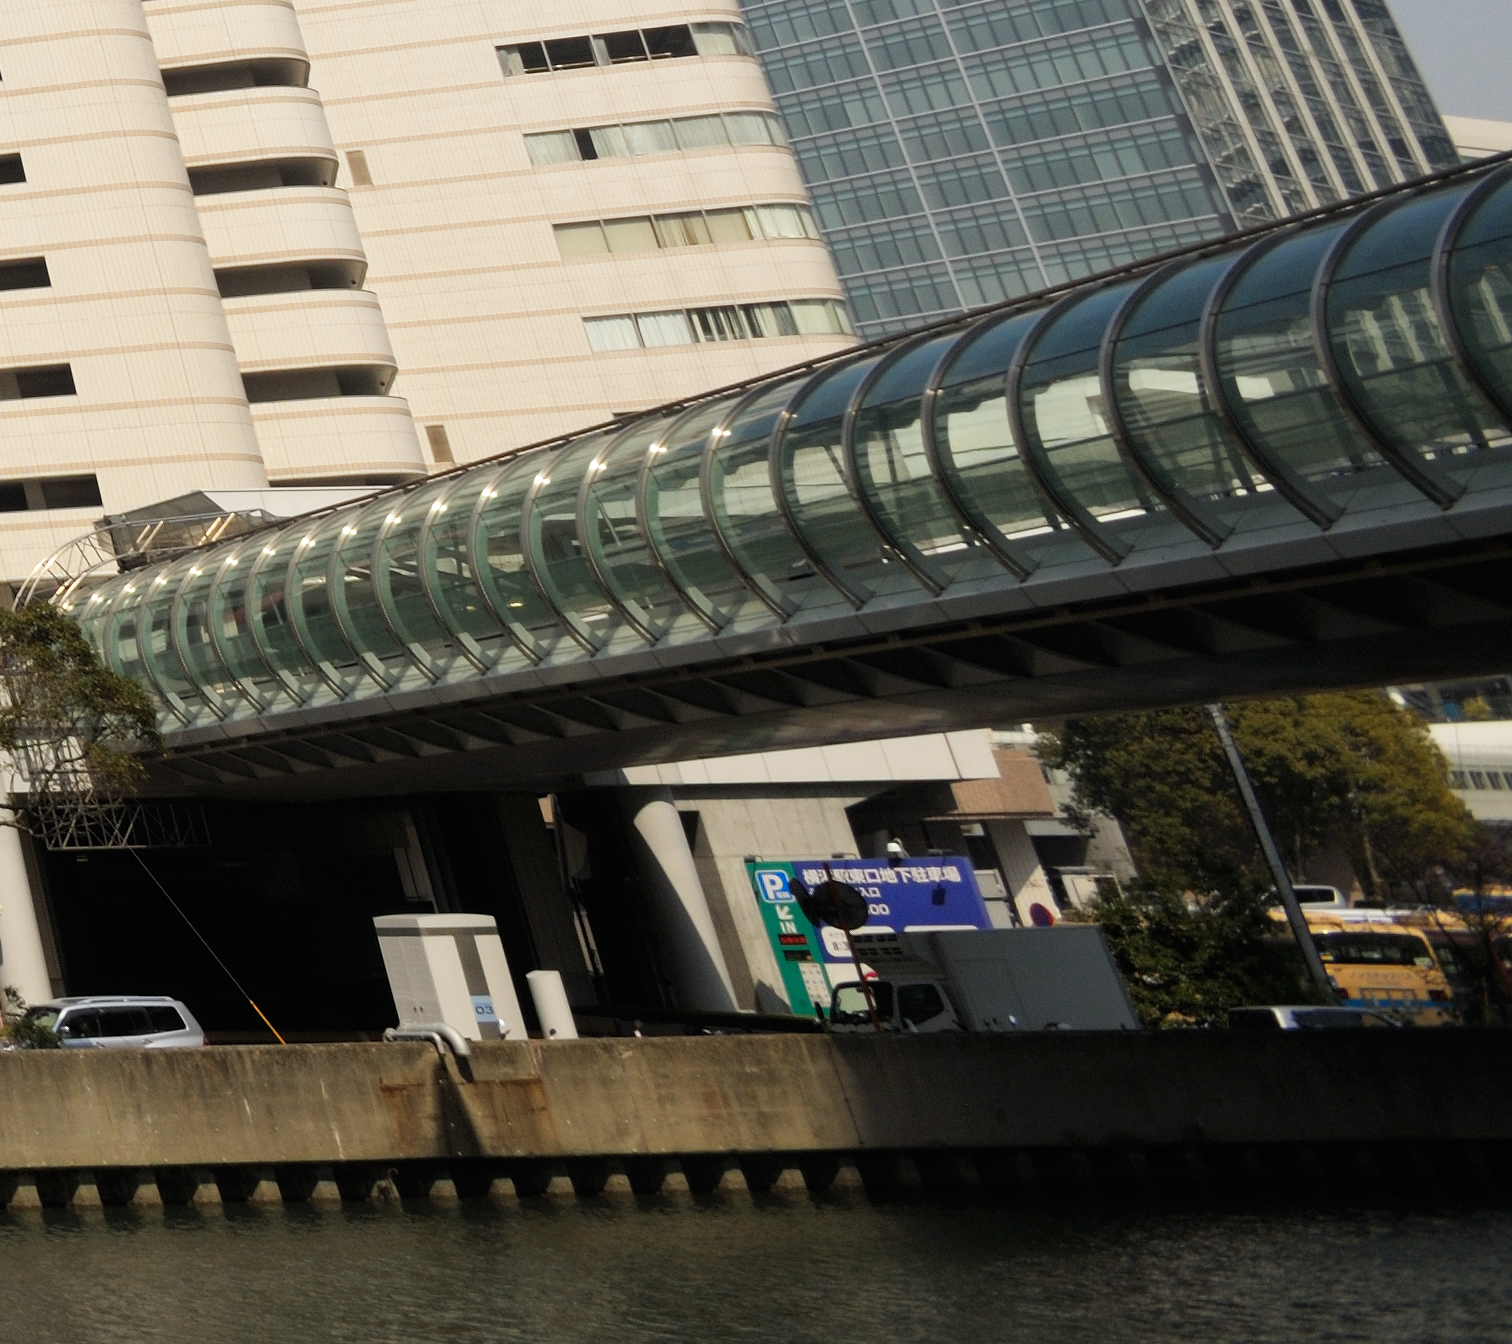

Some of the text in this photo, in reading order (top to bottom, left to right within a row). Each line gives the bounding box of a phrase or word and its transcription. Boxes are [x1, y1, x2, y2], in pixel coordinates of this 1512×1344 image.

[761, 874, 783, 900] P
[779, 921, 797, 934] IN
[474, 1005, 494, 1015] 03
